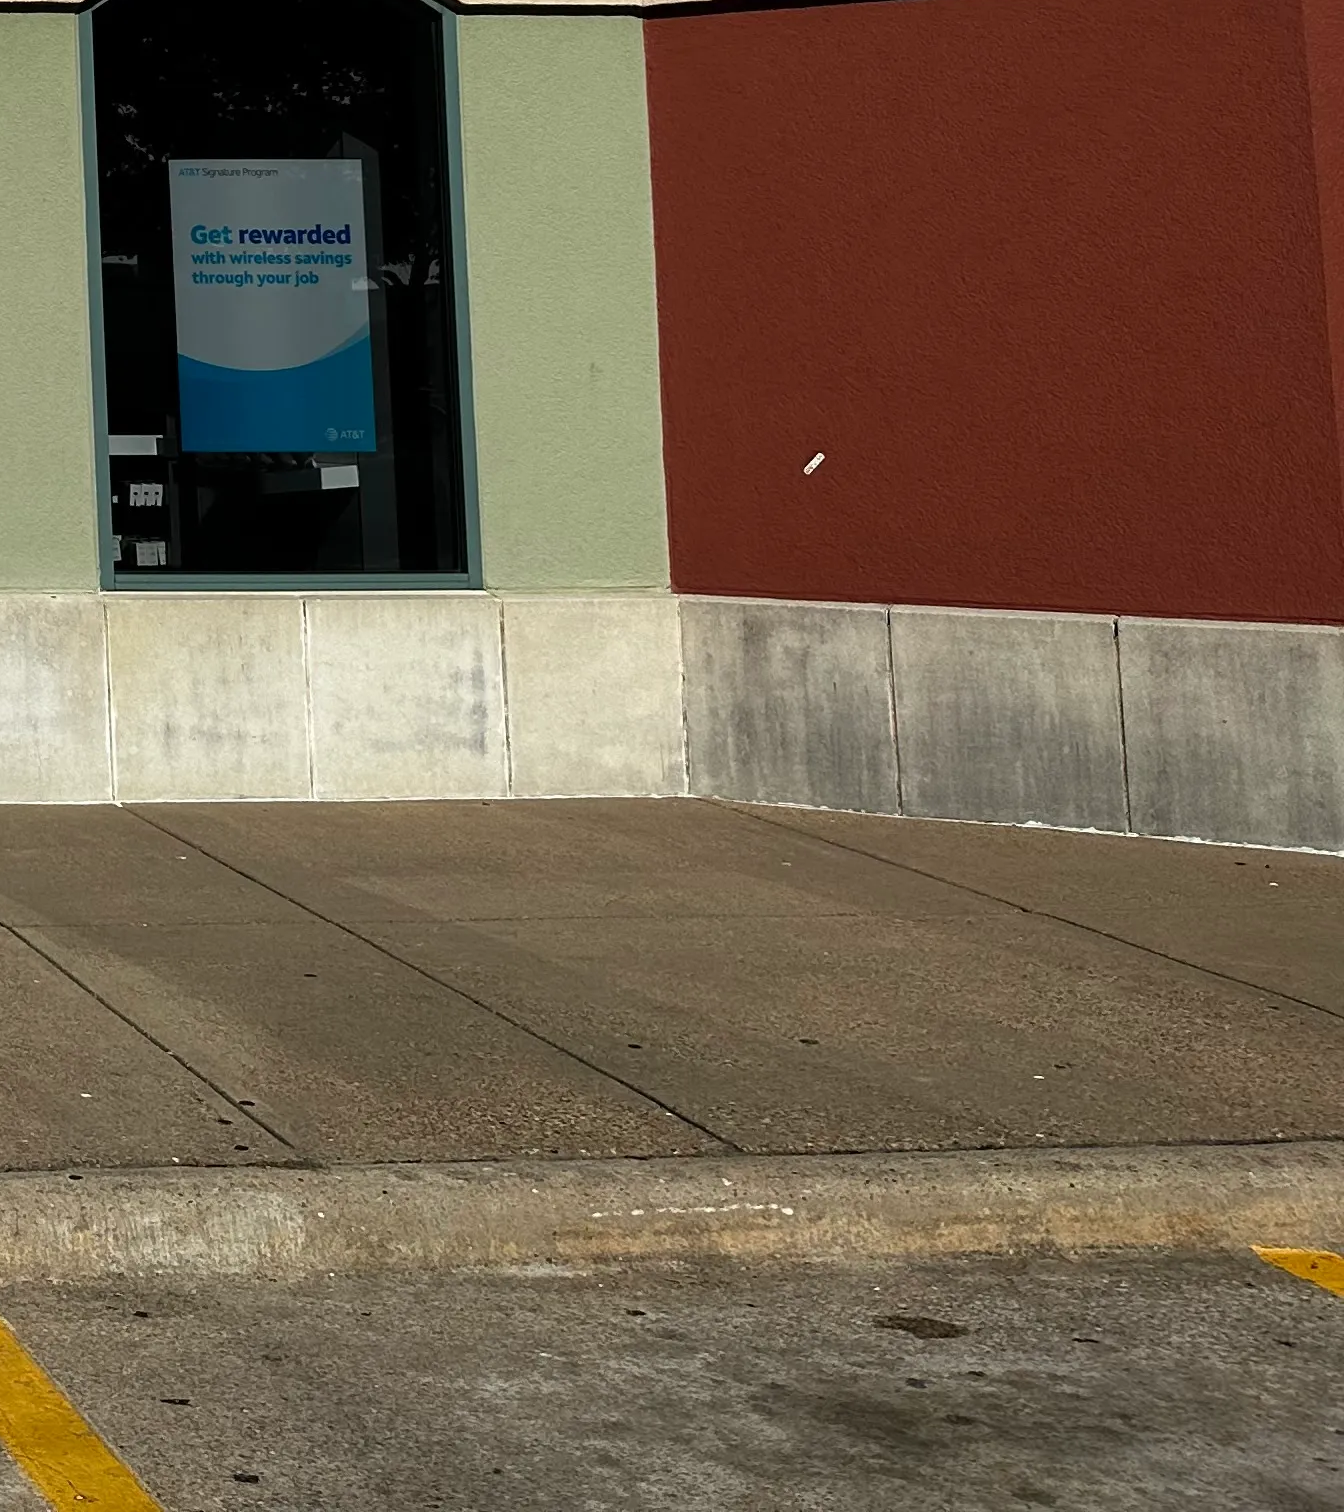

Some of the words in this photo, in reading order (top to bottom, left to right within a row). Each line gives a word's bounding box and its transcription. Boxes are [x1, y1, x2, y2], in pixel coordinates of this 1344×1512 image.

[202, 168, 241, 178] Signature
[242, 168, 279, 178] Program
[190, 224, 233, 244] Get
[238, 223, 352, 244] rewarded
[190, 250, 226, 265] with
[229, 250, 292, 265] wireless
[294, 250, 353, 268] savings
[191, 270, 254, 288] through
[256, 274, 292, 287] your
[293, 270, 320, 287] job
[340, 430, 365, 440] AT&T
